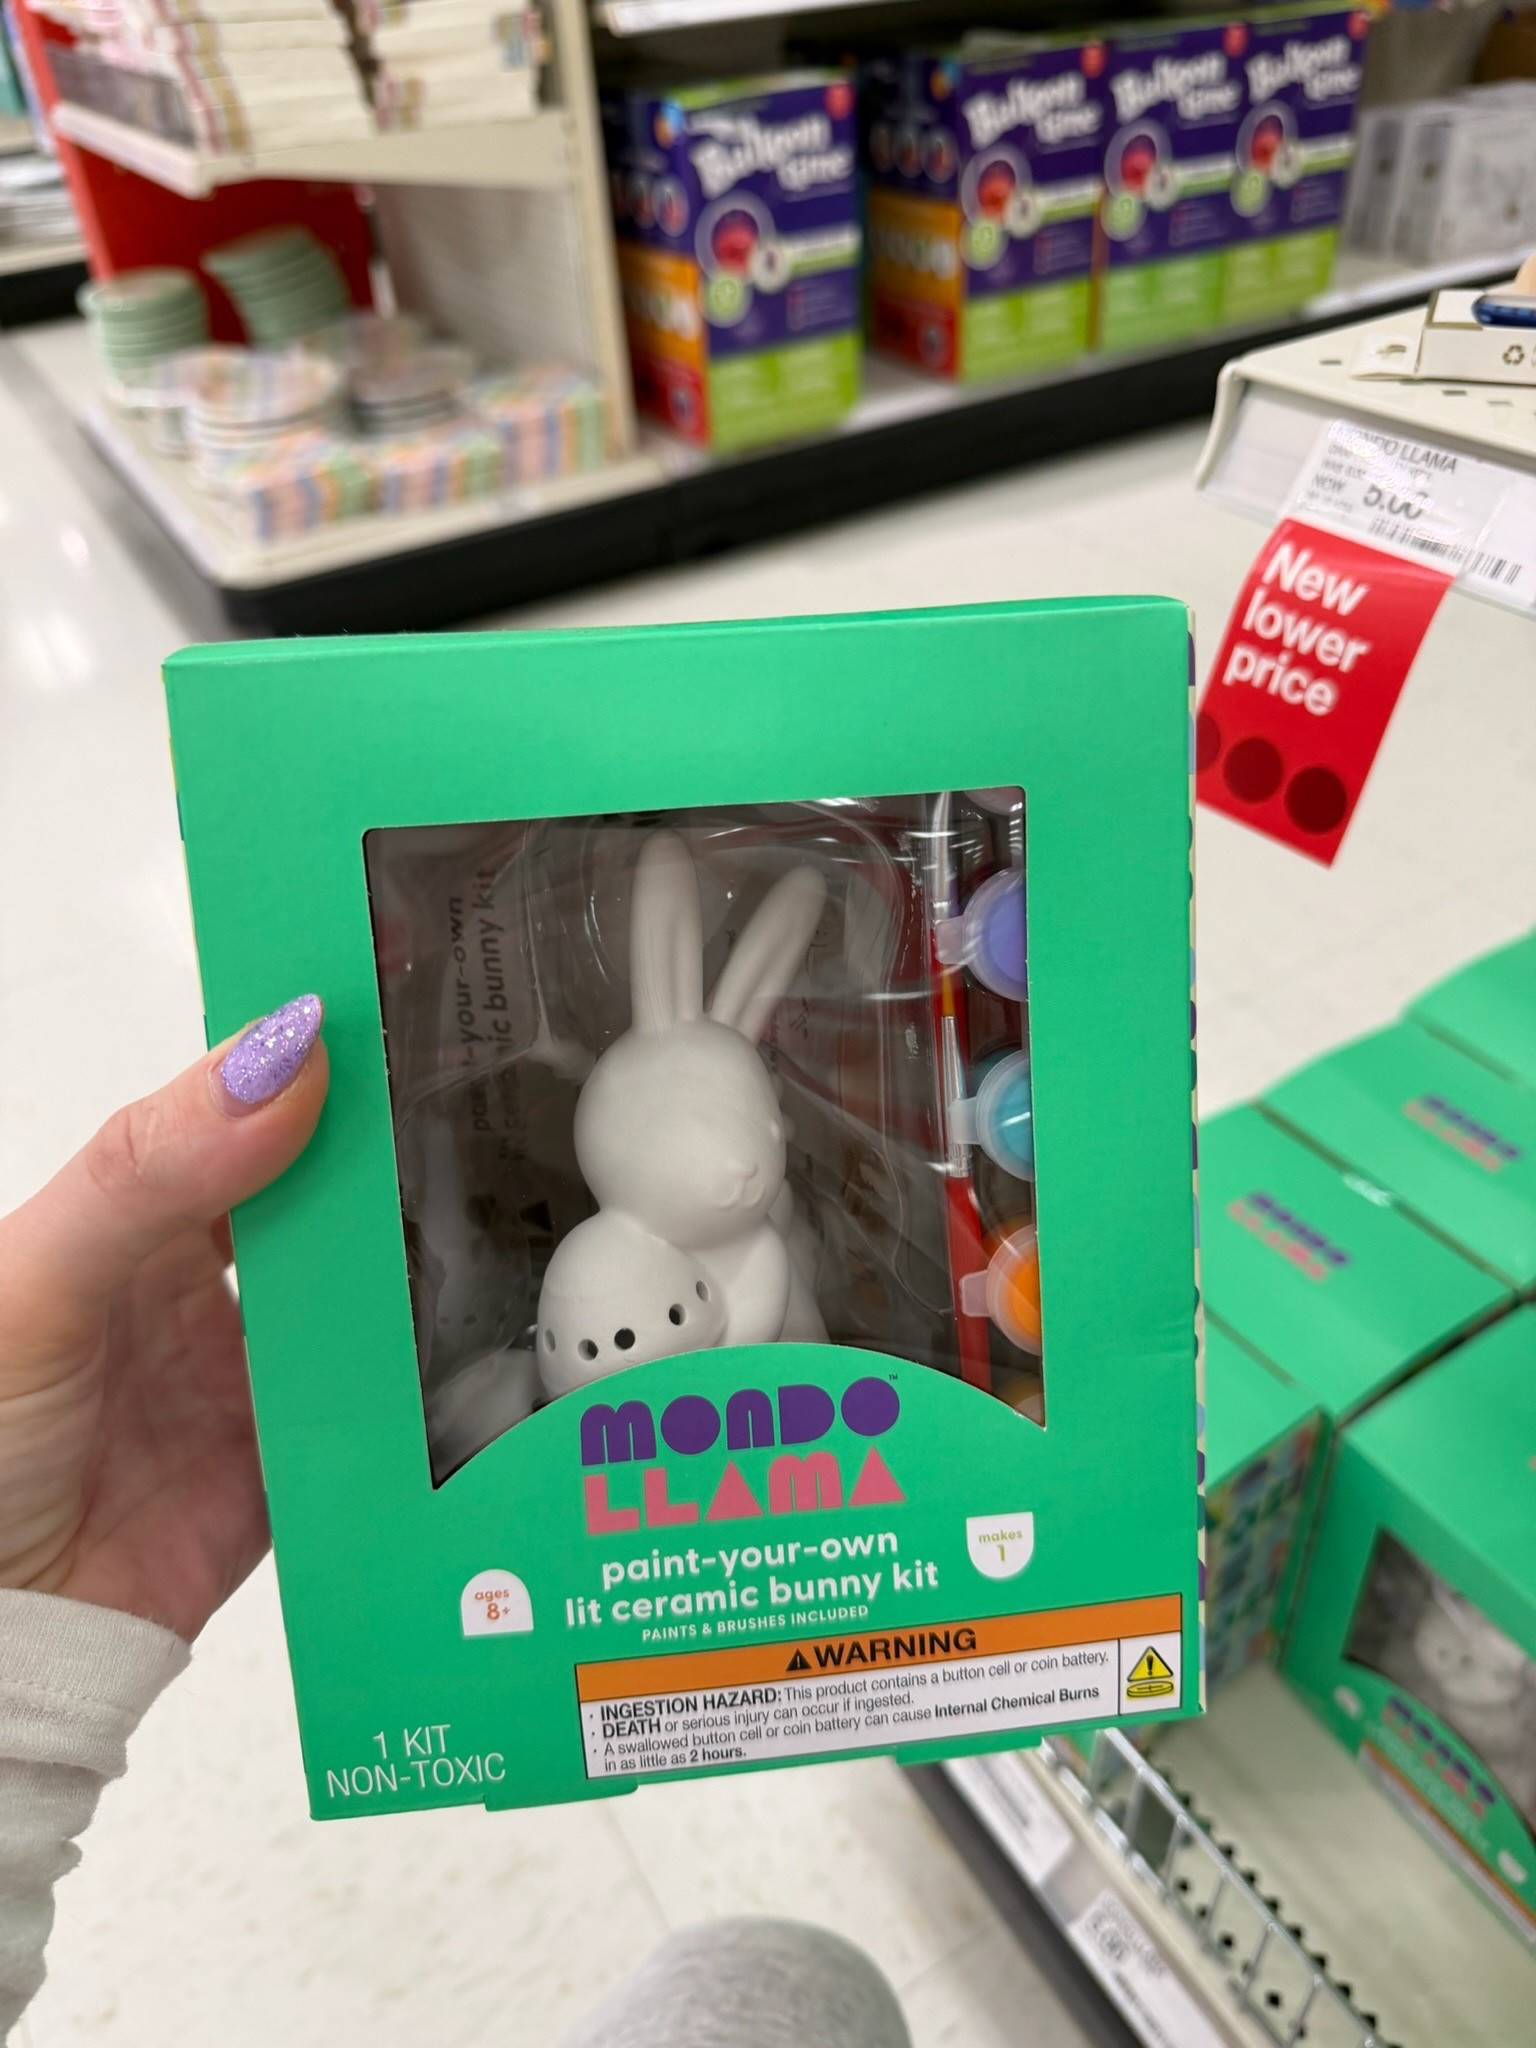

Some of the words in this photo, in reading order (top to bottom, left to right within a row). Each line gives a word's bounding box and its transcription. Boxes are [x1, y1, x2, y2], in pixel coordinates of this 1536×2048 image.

[1261, 542, 1369, 616] New
[1242, 586, 1372, 673] lower
[1222, 642, 1338, 716] price
[480, 917, 509, 1012] bunny
[580, 1376, 900, 1466] MONDO
[583, 1445, 907, 1536] LLAMA
[602, 1531, 899, 1590] paint-your-own
[978, 1530, 1023, 1543] makes
[997, 1544, 1005, 1562] 1
[474, 1589, 510, 1602] ages
[486, 1602, 511, 1620] 8+
[565, 1598, 602, 1627] lit
[611, 1580, 760, 1620] ceramic
[769, 1570, 882, 1605] bunny
[892, 1558, 940, 1591] kit
[642, 1623, 698, 1641] PAINTS
[702, 1622, 713, 1636] &
[717, 1614, 787, 1634] BRUSHES
[791, 1604, 869, 1625] INCLUDED
[814, 1627, 977, 1668] WARNING
[601, 1696, 698, 1721] INGESTION
[703, 1687, 782, 1710] HAZARD:
[784, 1684, 812, 1701] This
[816, 1680, 868, 1701] product
[871, 1672, 927, 1691] contains
[931, 1672, 939, 1684] a
[942, 1665, 985, 1682] button
[988, 1661, 1011, 1677] cell
[1014, 1662, 1027, 1673] or
[1031, 1655, 1058, 1672] coin
[1062, 1651, 1109, 1667] battery.
[373, 1731, 387, 1759] 1
[403, 1724, 451, 1757] KIT
[602, 1718, 661, 1739] DEATH
[665, 1720, 678, 1733] or
[682, 1712, 731, 1730] serious
[734, 1710, 769, 1726] injury
[773, 1707, 798, 1720] can
[802, 1702, 839, 1716] occur
[843, 1697, 851, 1711] if
[855, 1691, 914, 1712] ingested.
[604, 1742, 615, 1756] A
[618, 1737, 688, 1755] swallowed
[693, 1731, 736, 1746] button
[739, 1726, 762, 1741] cell
[766, 1726, 778, 1737] or
[783, 1721, 811, 1736] coin
[815, 1716, 860, 1732] battery
[865, 1714, 889, 1729] can
[892, 1708, 932, 1724] cause
[935, 1698, 987, 1718] Internal
[991, 1690, 1055, 1711] Chemical
[1059, 1686, 1100, 1701] Burns
[326, 1753, 506, 1798] NON-TOXIC
[604, 1758, 617, 1772] in
[620, 1759, 636, 1770] as
[640, 1753, 667, 1768] little
[670, 1753, 687, 1765] as
[690, 1749, 699, 1763] 2
[702, 1747, 747, 1761] hours.
